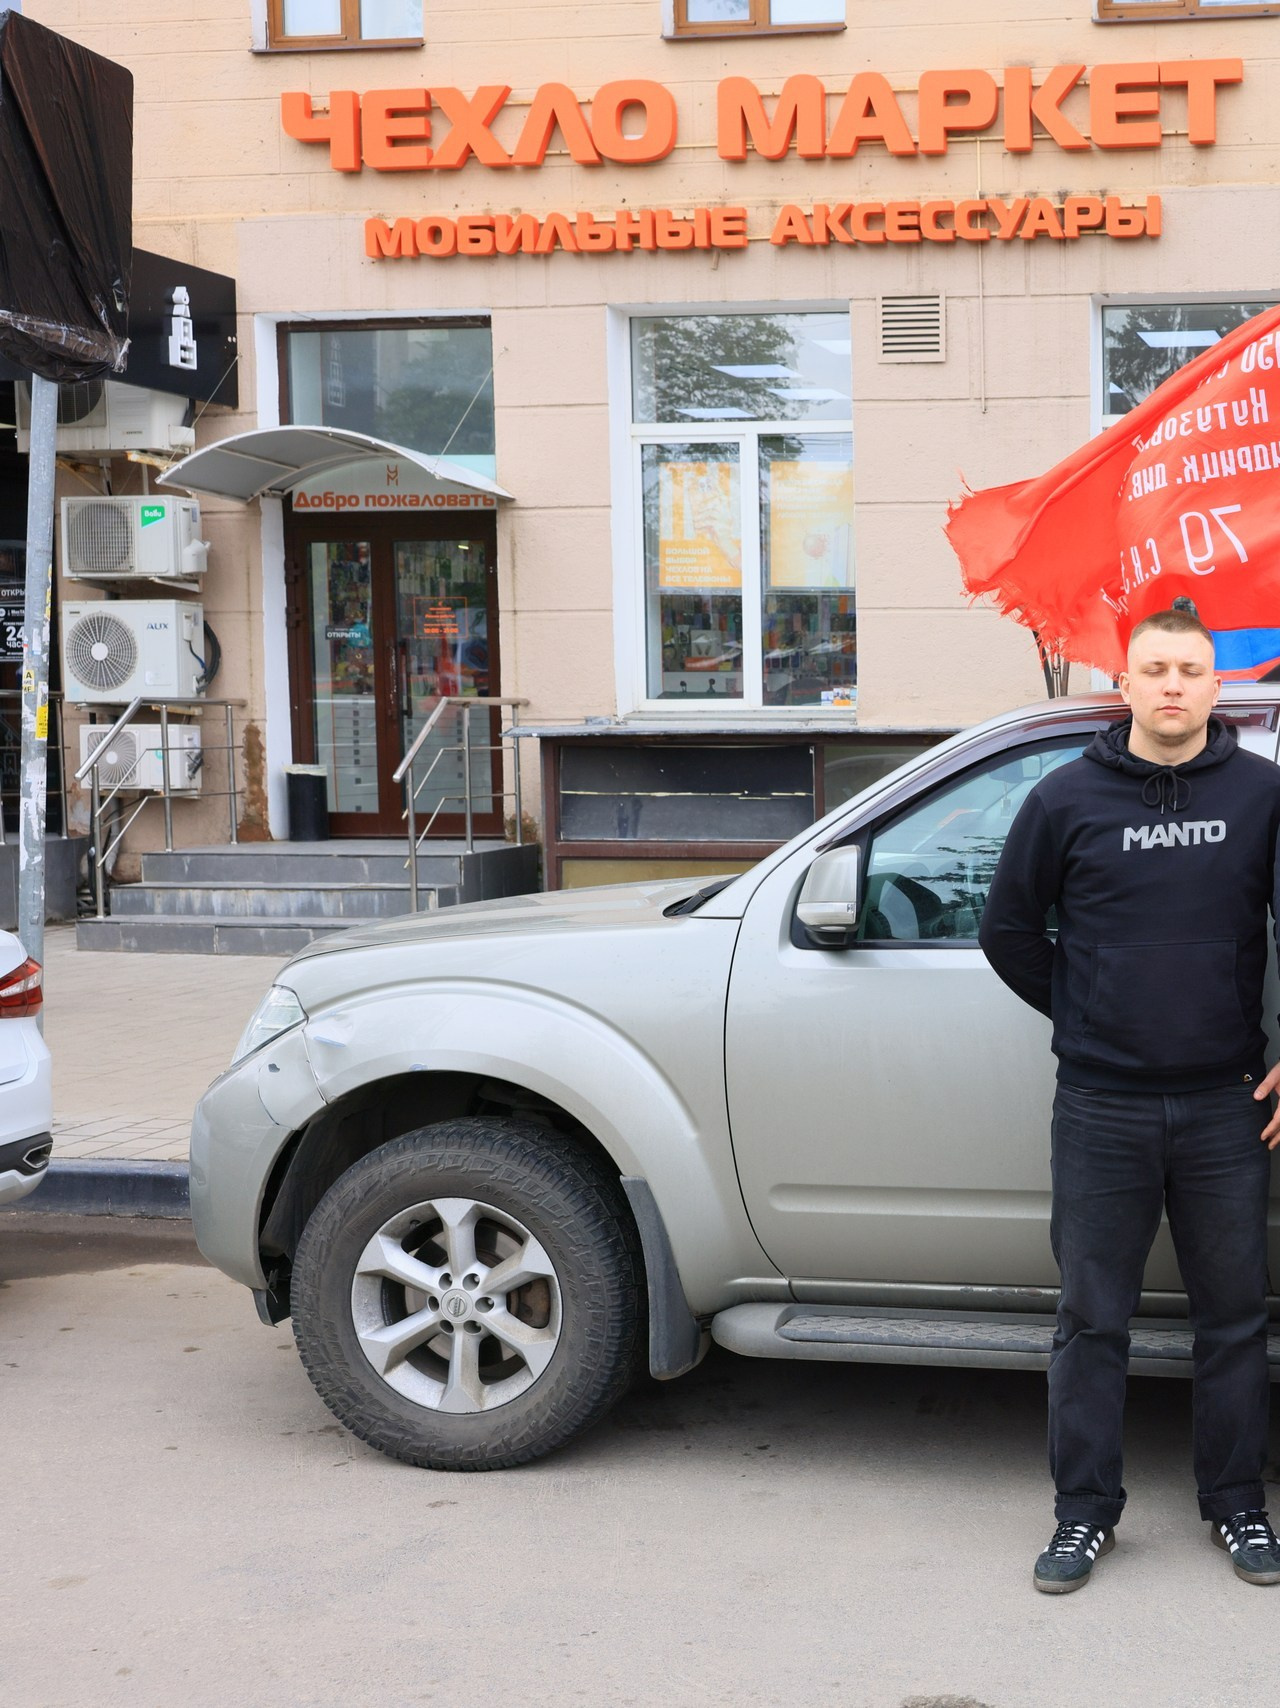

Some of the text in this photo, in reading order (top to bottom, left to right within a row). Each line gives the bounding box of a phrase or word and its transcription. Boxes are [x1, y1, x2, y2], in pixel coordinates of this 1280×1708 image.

[281, 57, 1243, 171] ЧЕХЛО МАРКЕТ
[365, 195, 1162, 258] МОБИЛЬНЫЕ АКСЕССУАРЫ
[294, 492, 495, 511] Добро пожаловать
[1123, 820, 1226, 851] MANTO
